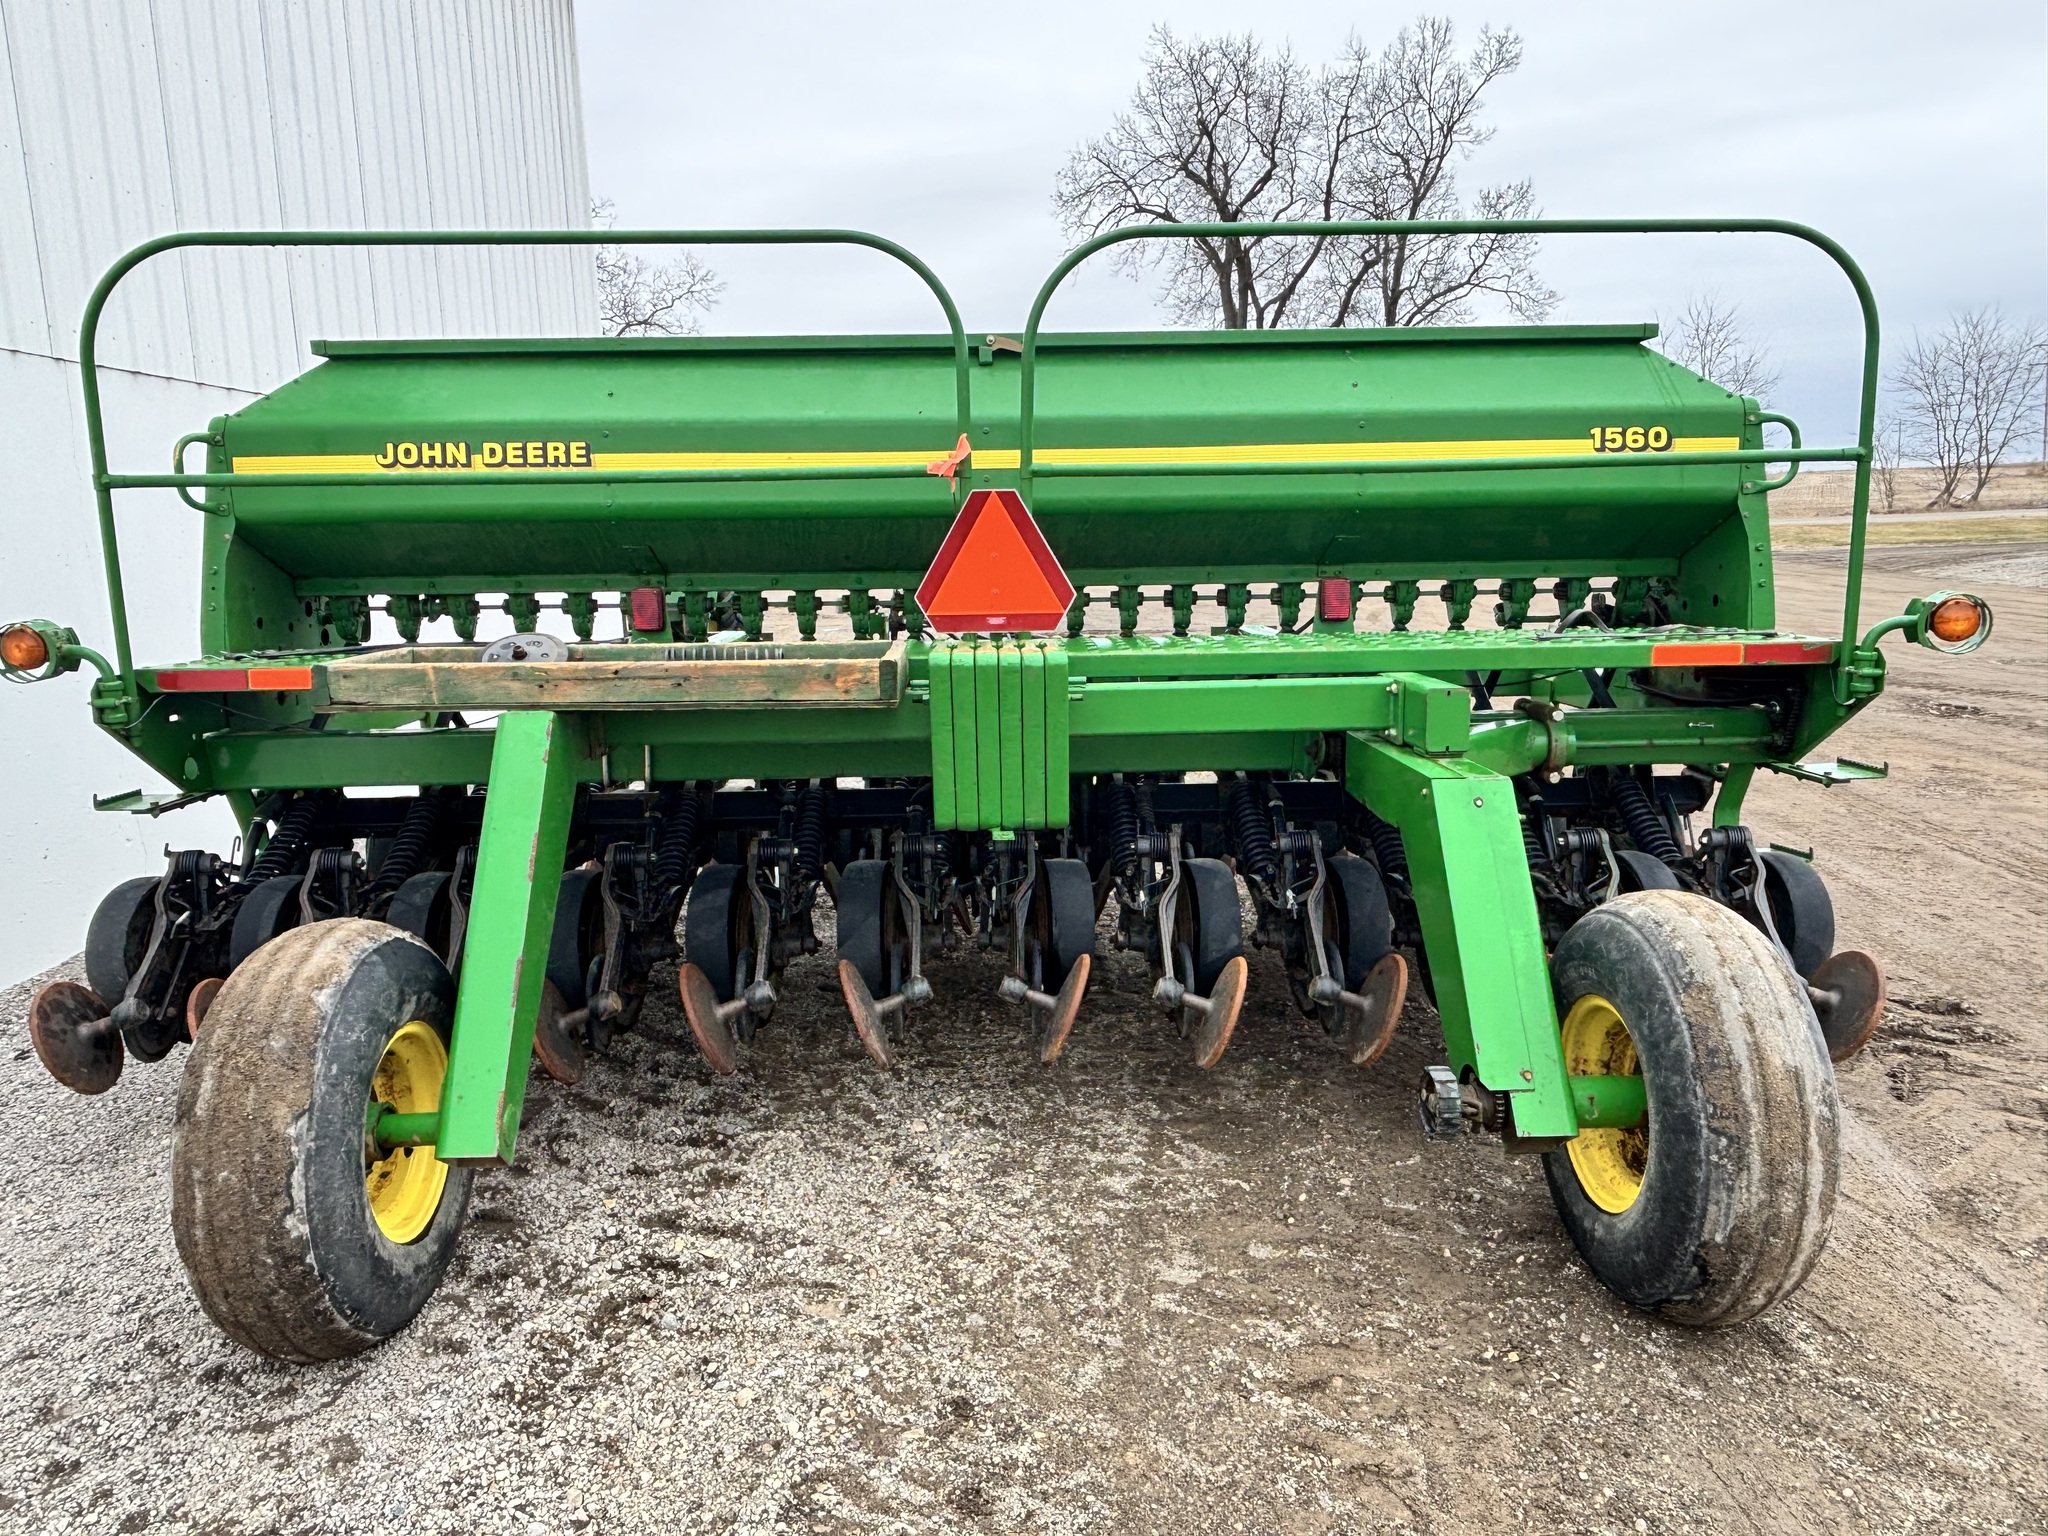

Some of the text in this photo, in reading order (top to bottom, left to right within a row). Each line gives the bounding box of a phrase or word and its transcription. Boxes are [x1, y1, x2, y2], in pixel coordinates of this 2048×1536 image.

[1590, 426, 1672, 452] 1560
[376, 441, 591, 468] JOHN DEERE
